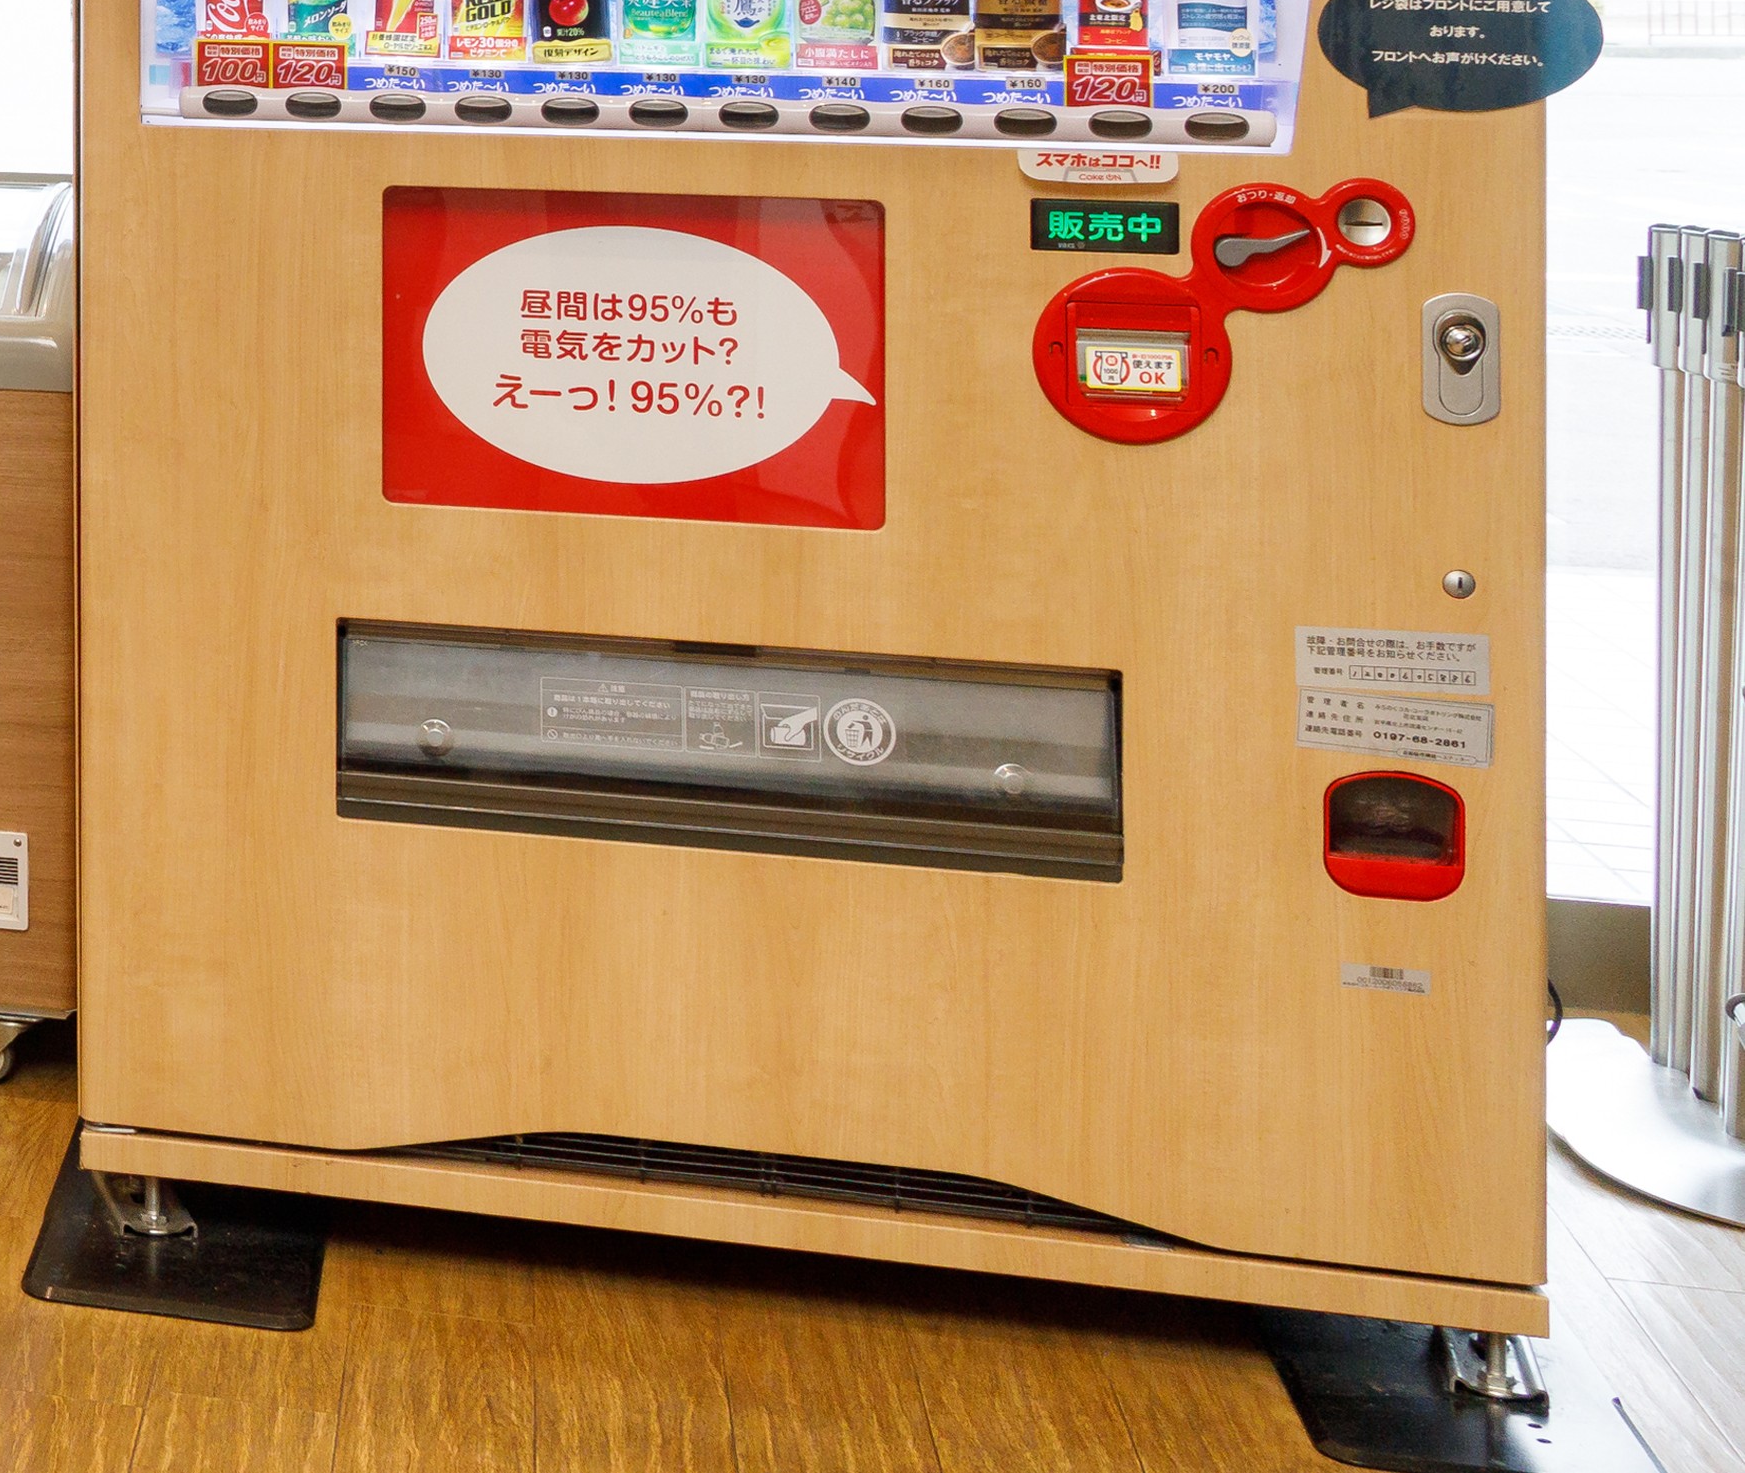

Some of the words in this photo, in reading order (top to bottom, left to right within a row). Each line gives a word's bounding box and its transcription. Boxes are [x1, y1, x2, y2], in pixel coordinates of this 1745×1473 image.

[465, 0, 512, 23] GOLD
[1429, 25, 1485, 39] おります。
[220, 46, 261, 58] 特別価格
[295, 46, 336, 58] 特別価格
[1371, 50, 1545, 67] フロントへお声がけください。
[1047, 211, 1163, 243] 販売中
[520, 289, 738, 326] 昼間は95%も
[520, 329, 739, 365] 電気をカット?
[1139, 371, 1166, 385] OK
